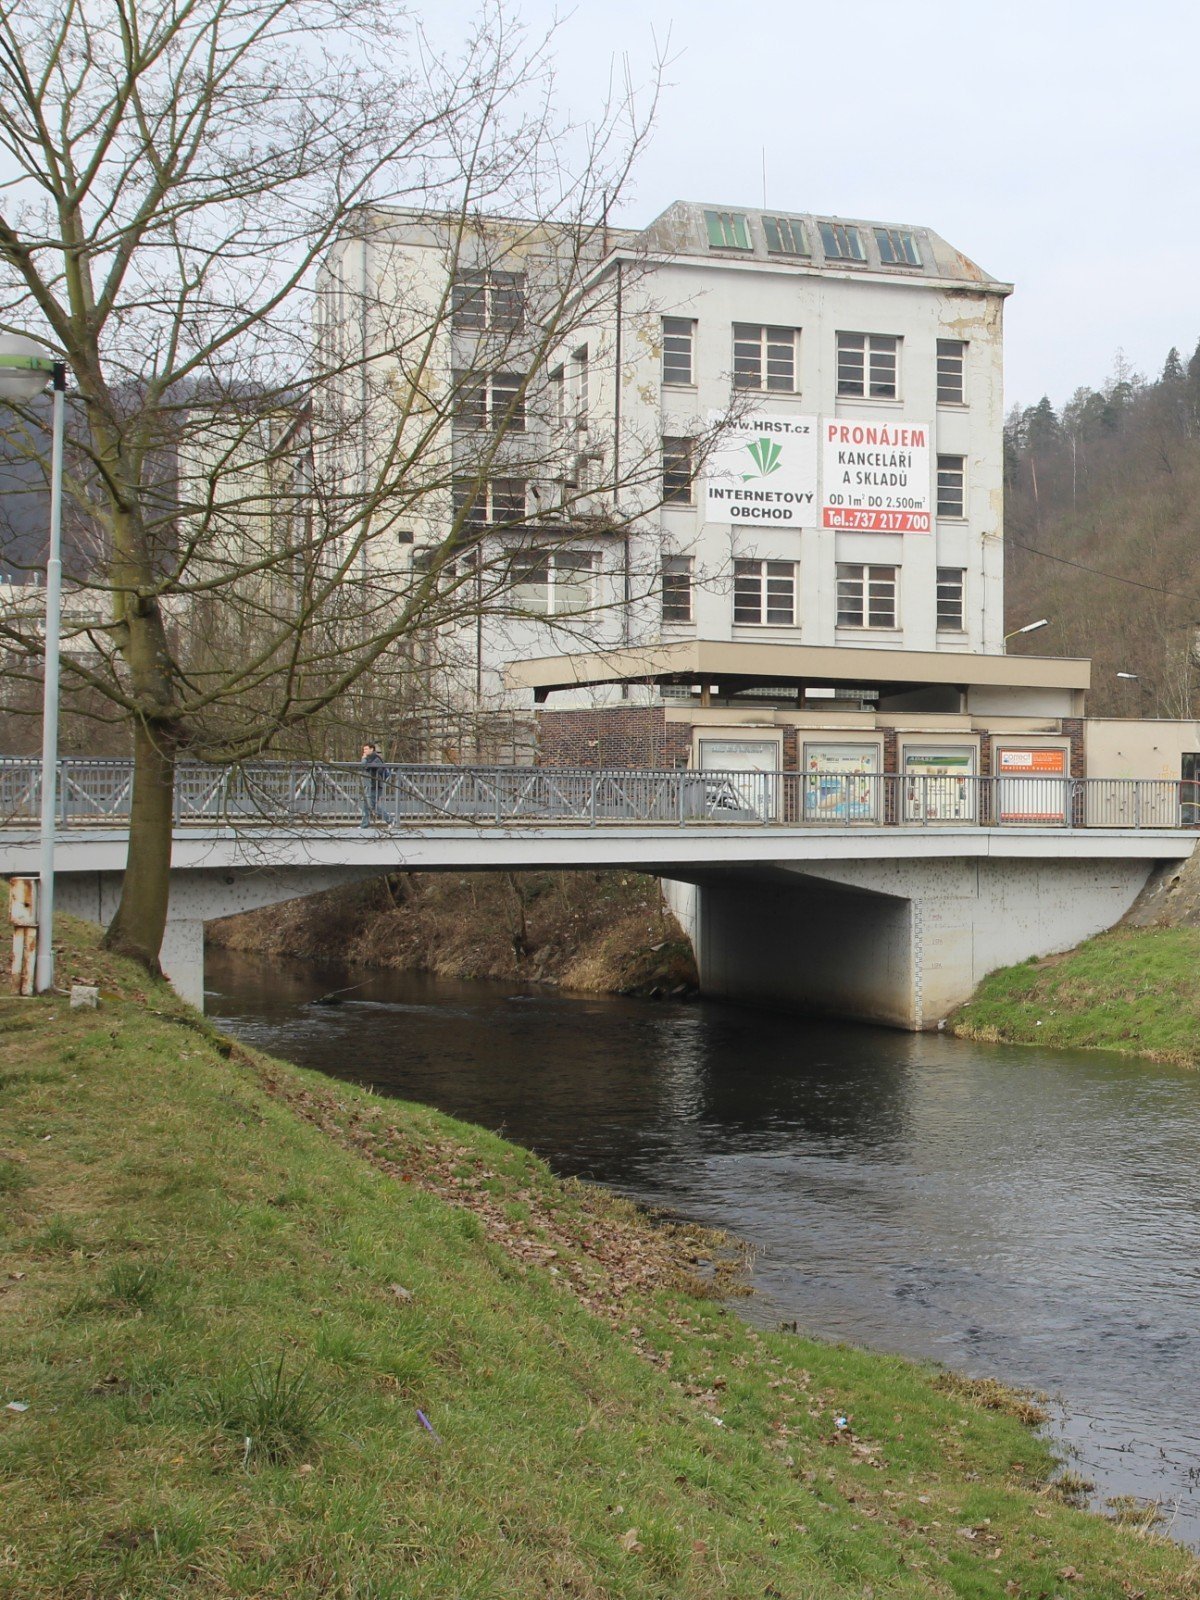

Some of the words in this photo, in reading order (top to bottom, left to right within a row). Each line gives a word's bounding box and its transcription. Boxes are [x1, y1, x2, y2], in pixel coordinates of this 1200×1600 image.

[828, 424, 925, 447] PRONÁJEM
[838, 450, 912, 468] KANCELÁŘÍ
[843, 470, 851, 484] A
[856, 470, 908, 487] SKLADŮ
[709, 487, 814, 503] INTERNETOVÝ
[829, 493, 844, 505] OD
[868, 495, 883, 507] DO
[730, 506, 793, 519] OBCHOD
[880, 512, 904, 528] 217
[906, 514, 929, 529] 700
